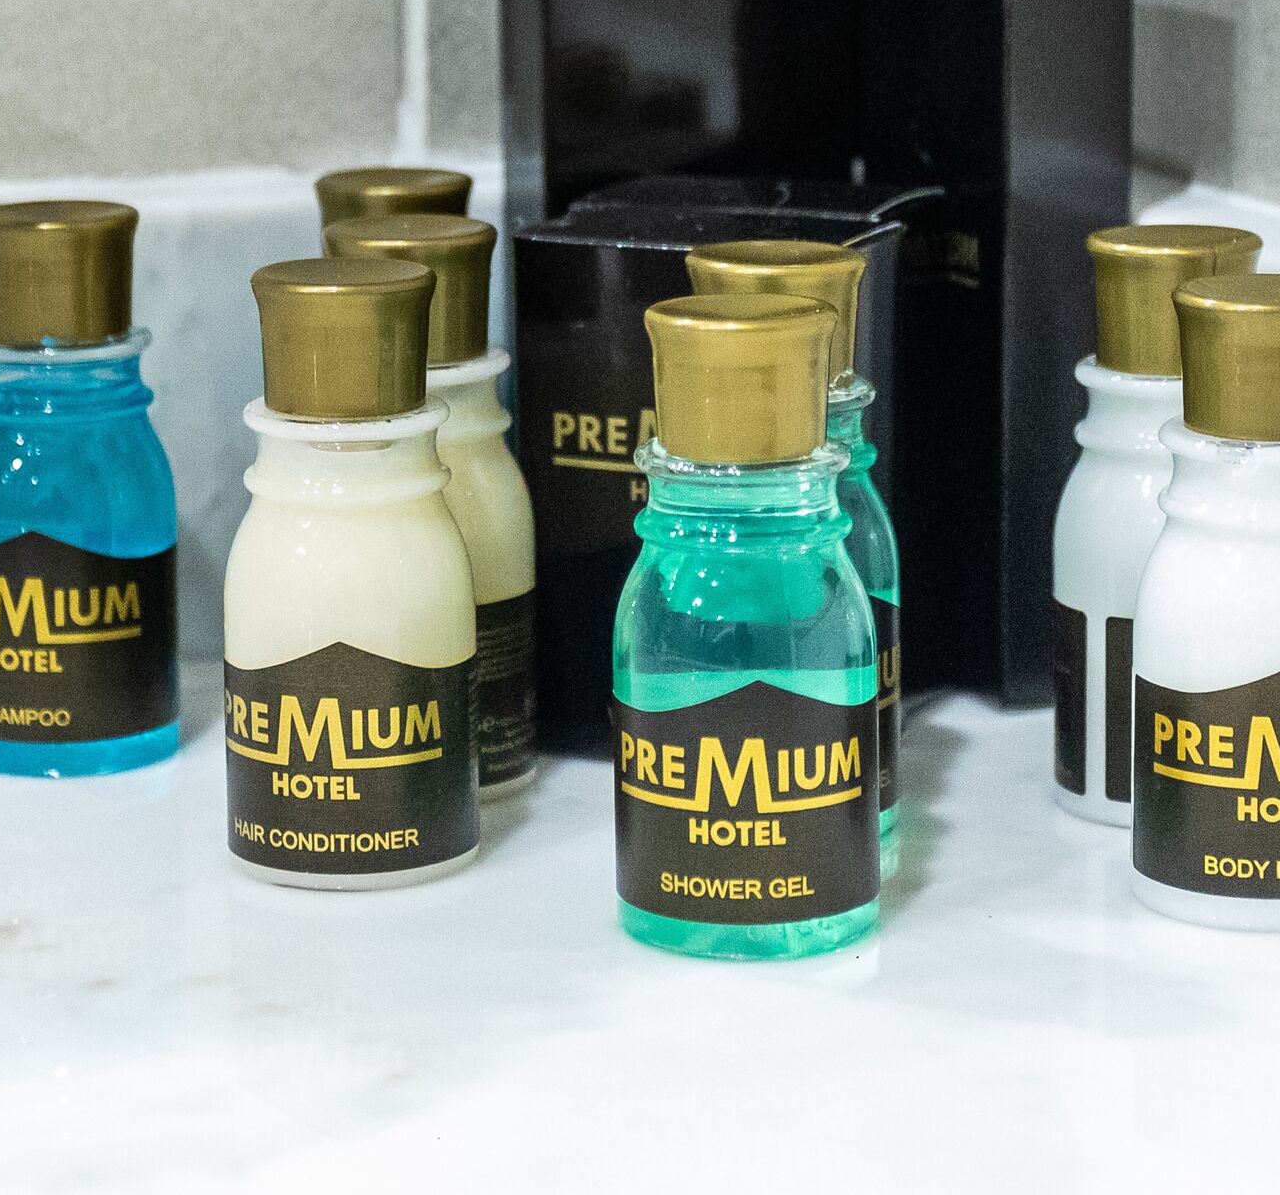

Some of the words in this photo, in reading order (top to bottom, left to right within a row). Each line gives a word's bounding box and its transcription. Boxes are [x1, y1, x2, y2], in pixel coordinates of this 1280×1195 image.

[272, 771, 361, 800] HOTEL
[621, 730, 862, 814] PREMIUM
[234, 816, 266, 845] HAIR
[269, 827, 420, 853] CONDITIONER
[688, 817, 787, 847] HOTEL
[1203, 854, 1270, 879] BODY
[660, 870, 763, 900] SHOWER
[768, 875, 815, 898] GEL
